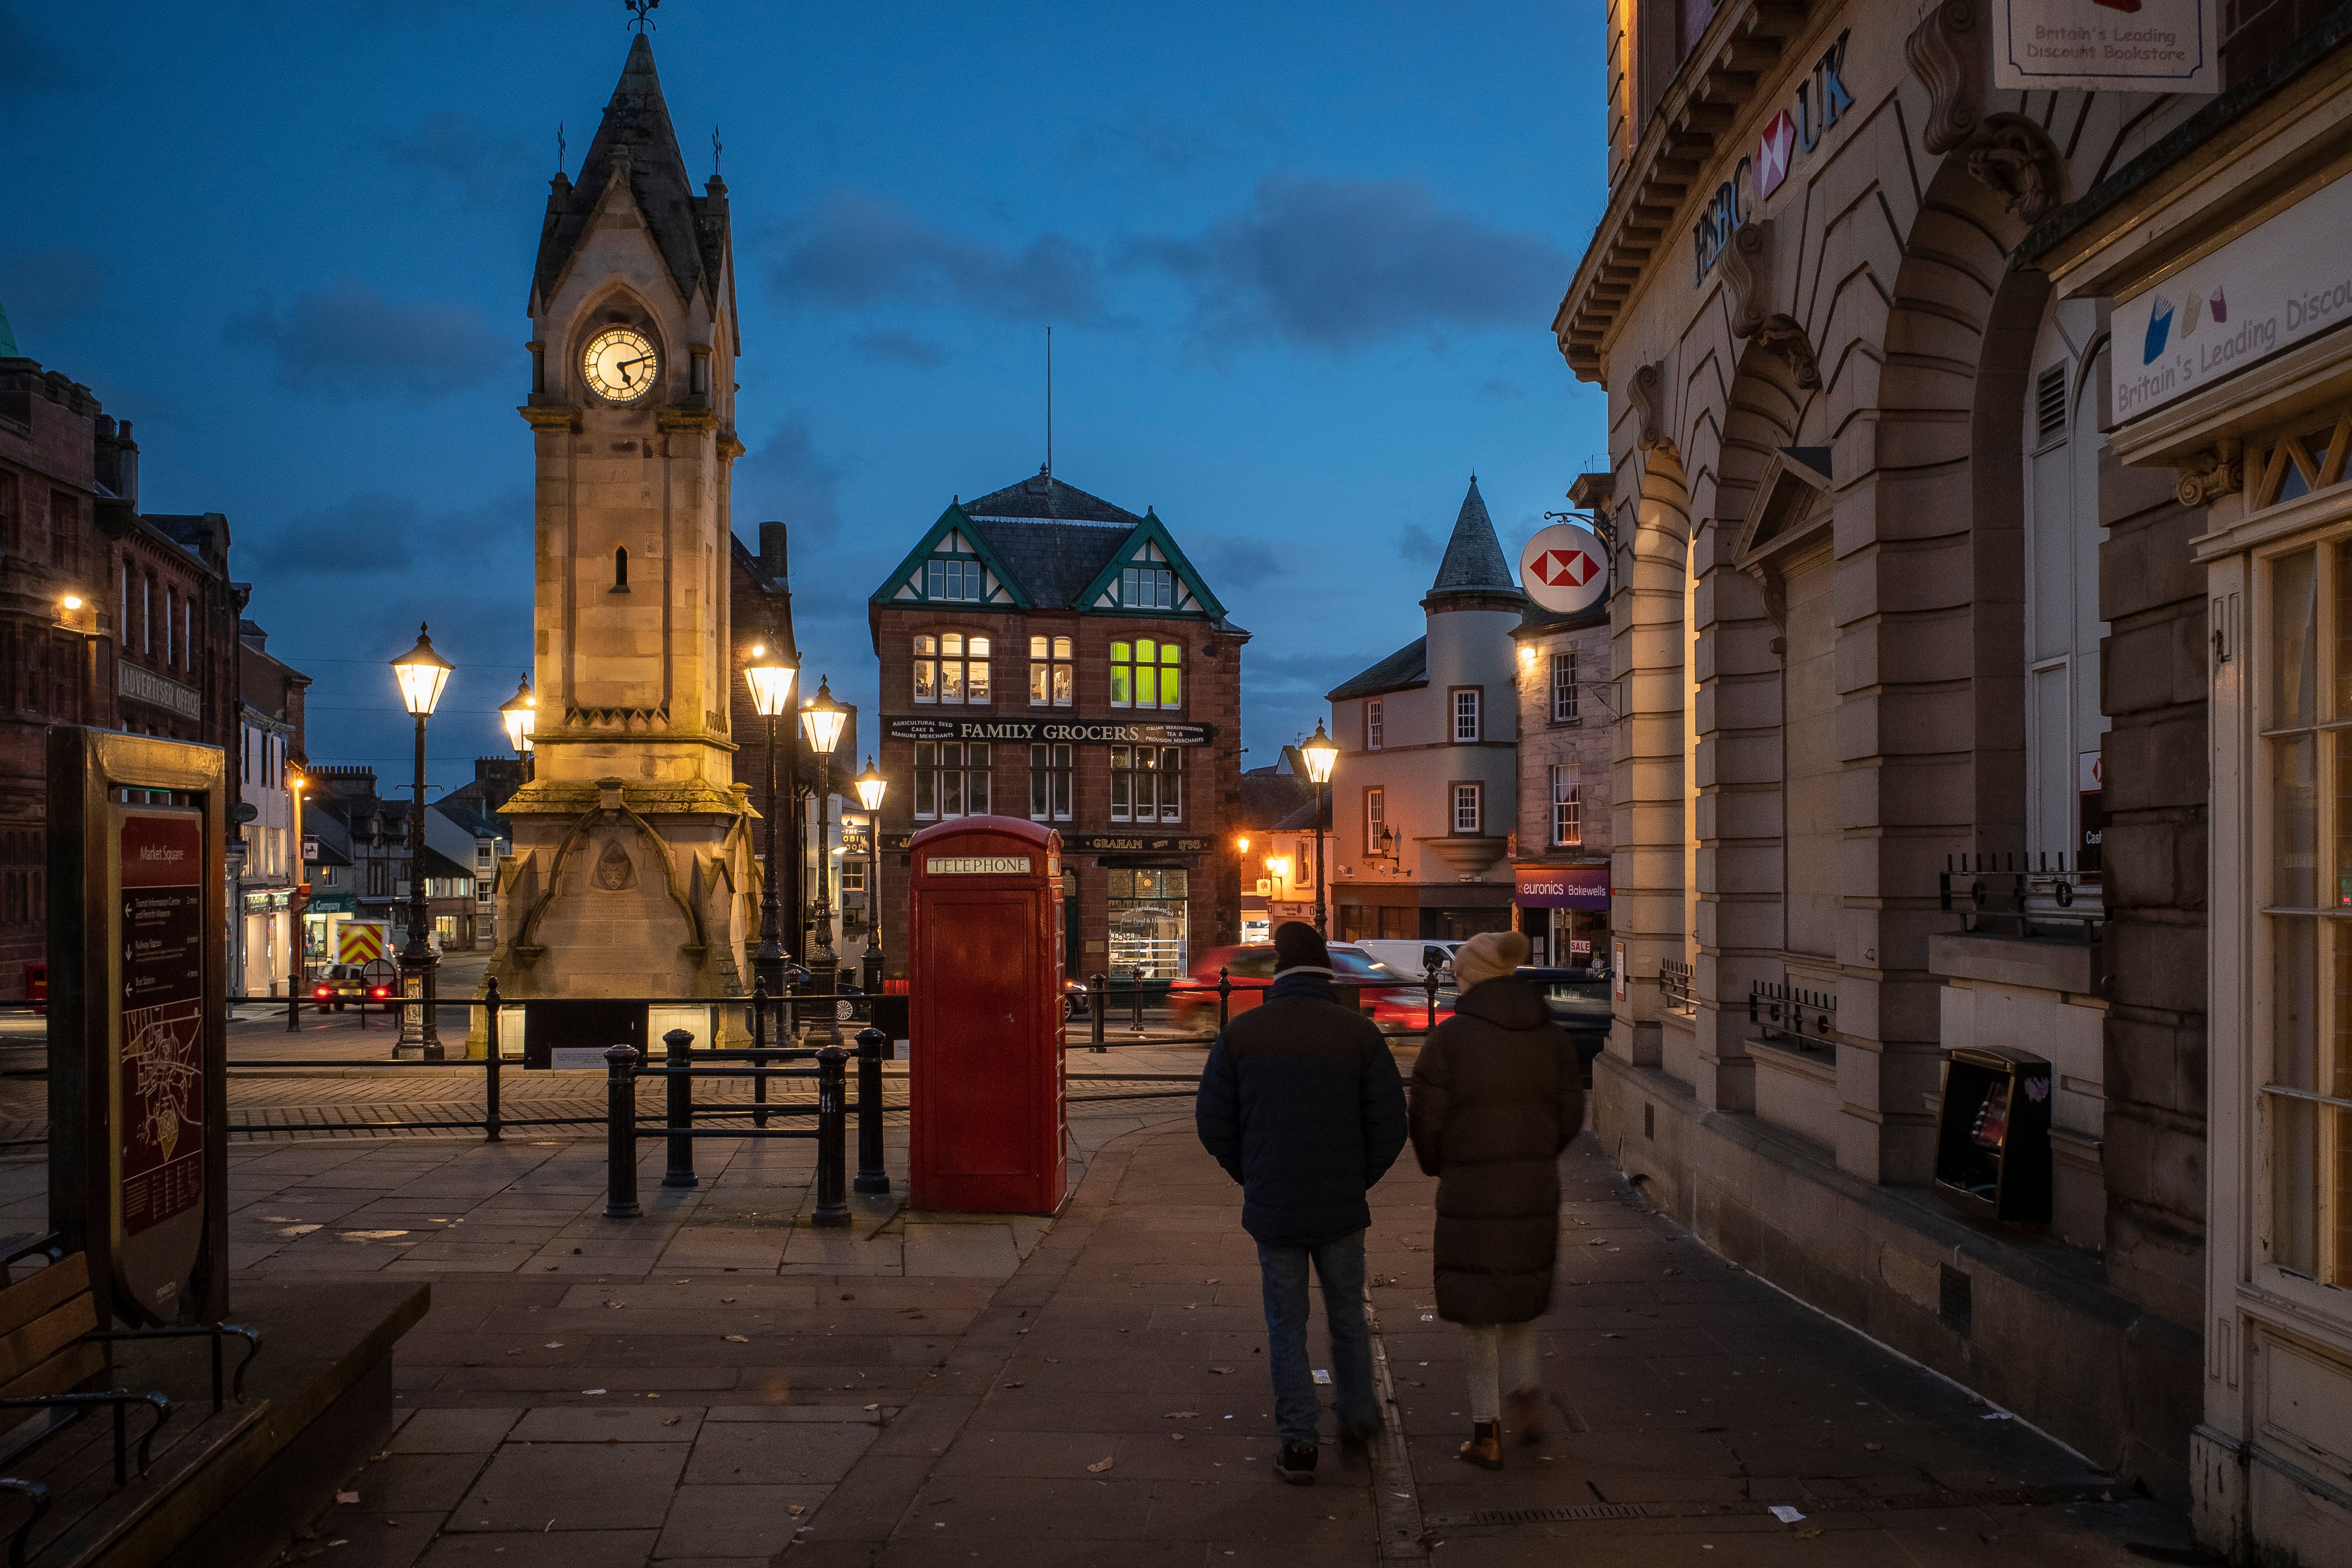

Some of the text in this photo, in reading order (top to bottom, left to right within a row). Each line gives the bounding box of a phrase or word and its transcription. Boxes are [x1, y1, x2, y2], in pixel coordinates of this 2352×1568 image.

[2035, 25, 2176, 46] Britain's Leading
[2026, 44, 2185, 61] Discount Bookstore
[1693, 28, 1855, 290] HSBC UK
[2119, 355, 2192, 413] Britain's
[2201, 317, 2277, 373] Leading
[125, 668, 173, 706] ADVERTISER
[960, 723, 1139, 741] FAMILY GROCERS
[1093, 839, 1143, 849] GRAHAM
[1179, 840, 1201, 851] 1793
[140, 844, 184, 865] Market Square
[934, 858, 1027, 872] TELEPHONE
[1524, 880, 1606, 896] euronics Bakewells
[316, 900, 341, 912] Company
[1122, 905, 1174, 917] www.jjgraham.co.uk
[1571, 942, 1589, 952] SALE
